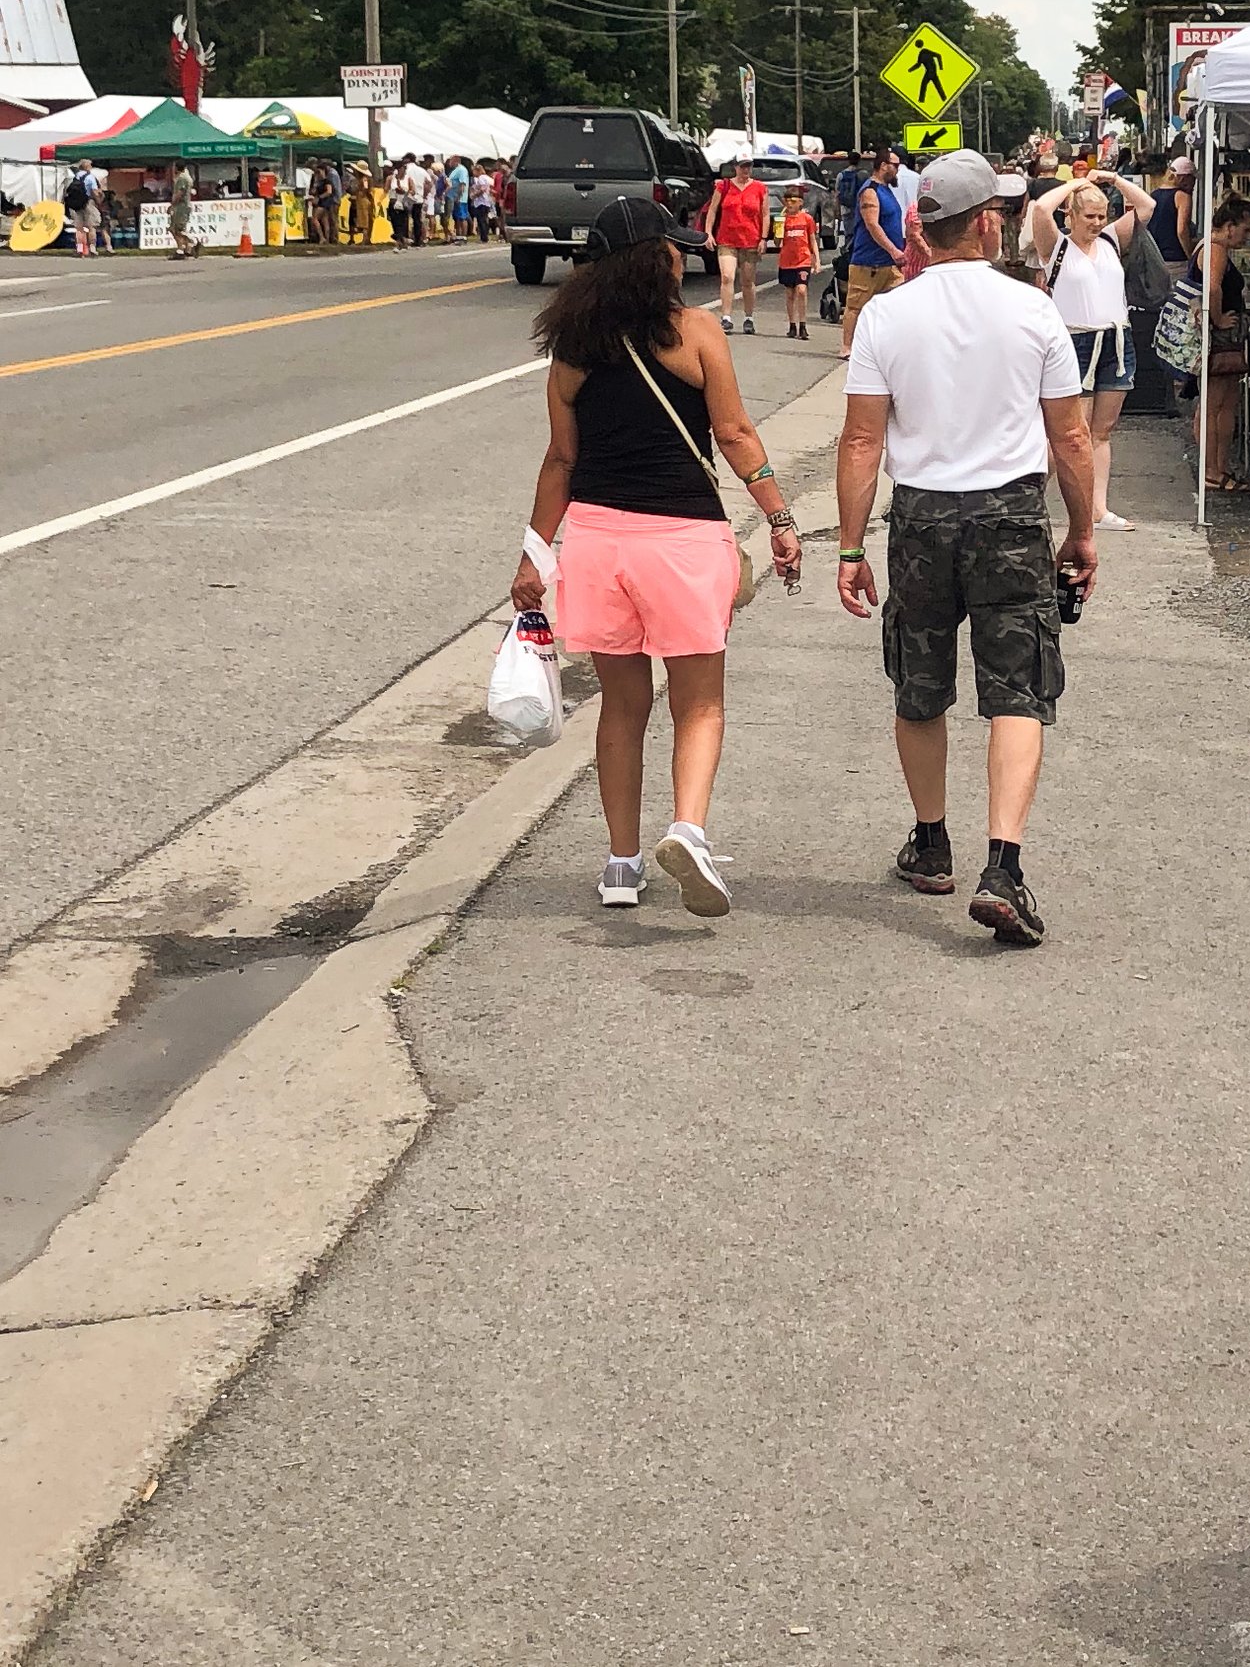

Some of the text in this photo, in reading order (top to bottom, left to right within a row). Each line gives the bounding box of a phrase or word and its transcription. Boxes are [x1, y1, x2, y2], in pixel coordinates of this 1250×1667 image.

[1182, 31, 1237, 43] BREAK
[343, 68, 401, 77] LOBSTER
[347, 79, 398, 88] DINNER
[142, 202, 261, 214] SAUE ONIONS
[156, 214, 227, 224] PPERS
[144, 236, 175, 246] HOT
